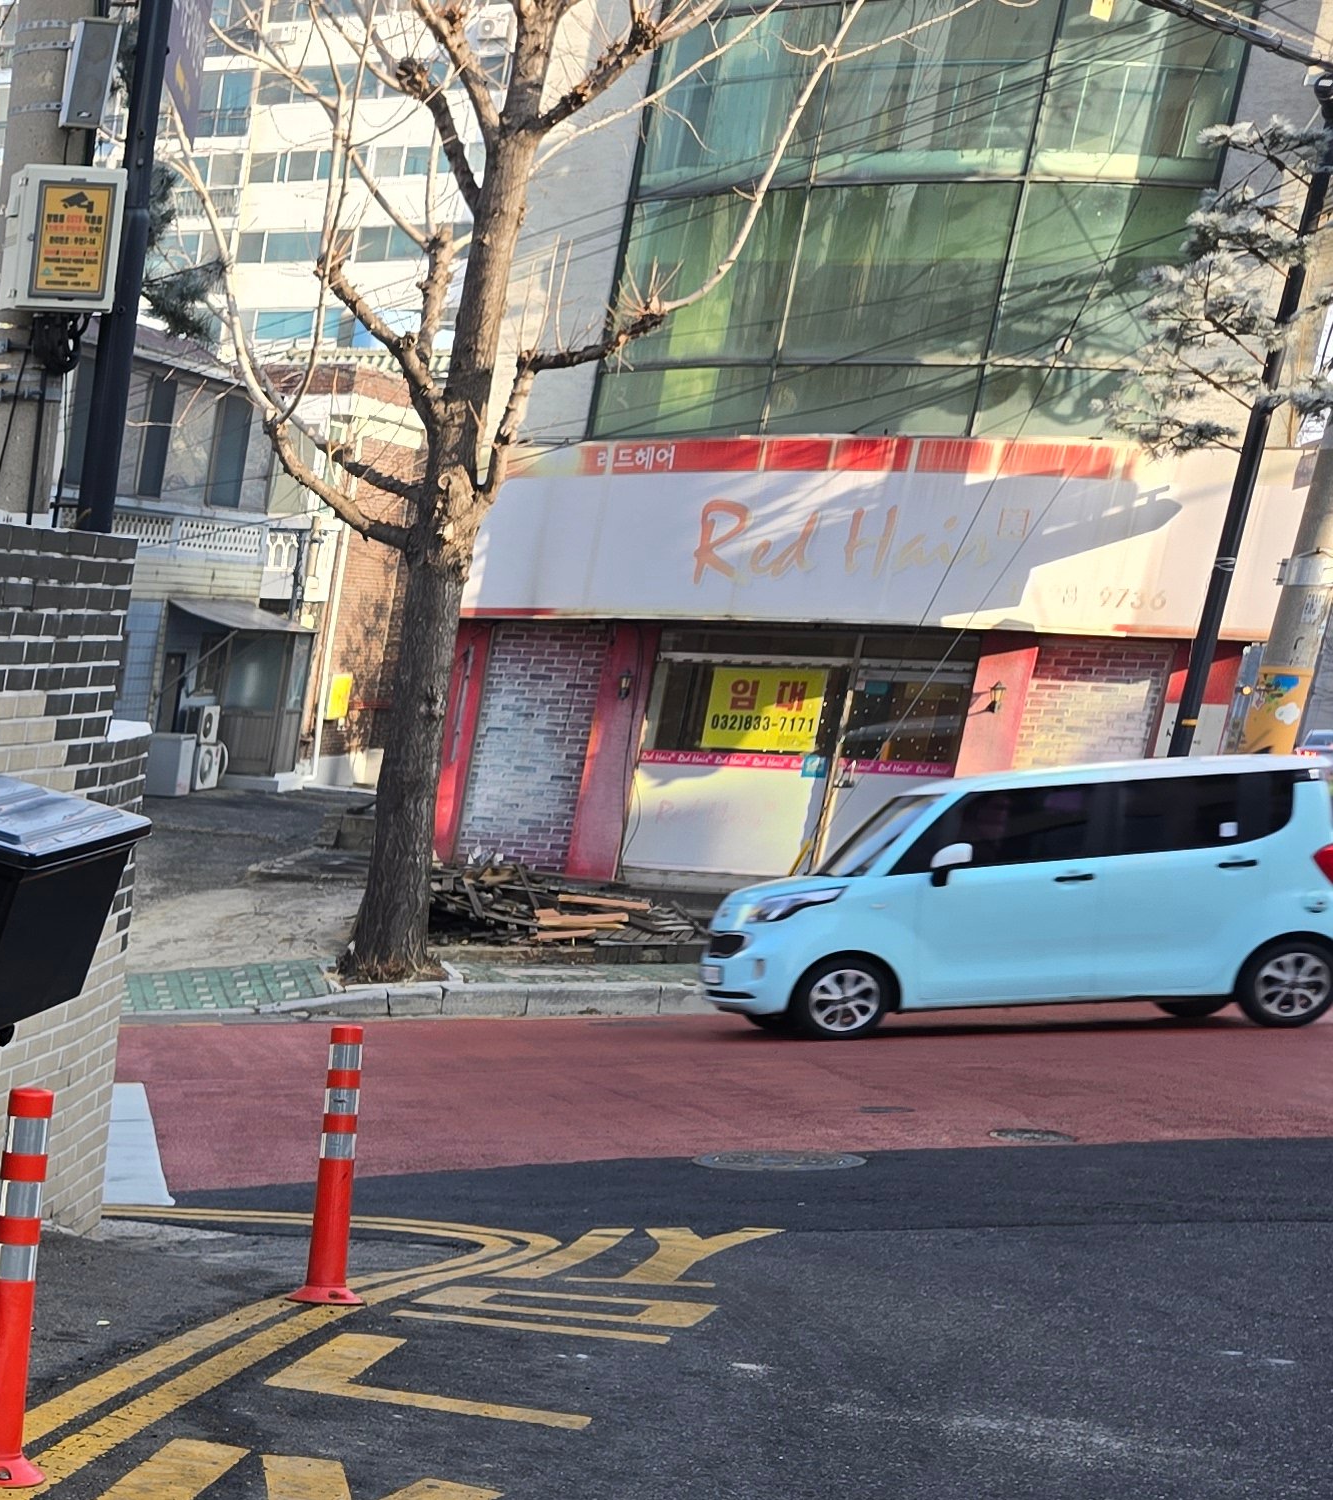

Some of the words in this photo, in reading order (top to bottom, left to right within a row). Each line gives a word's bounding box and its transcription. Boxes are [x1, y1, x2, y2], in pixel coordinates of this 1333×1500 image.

[693, 499, 819, 585] Red
[844, 505, 993, 577] Hair
[710, 713, 815, 733] 032)833-7171
